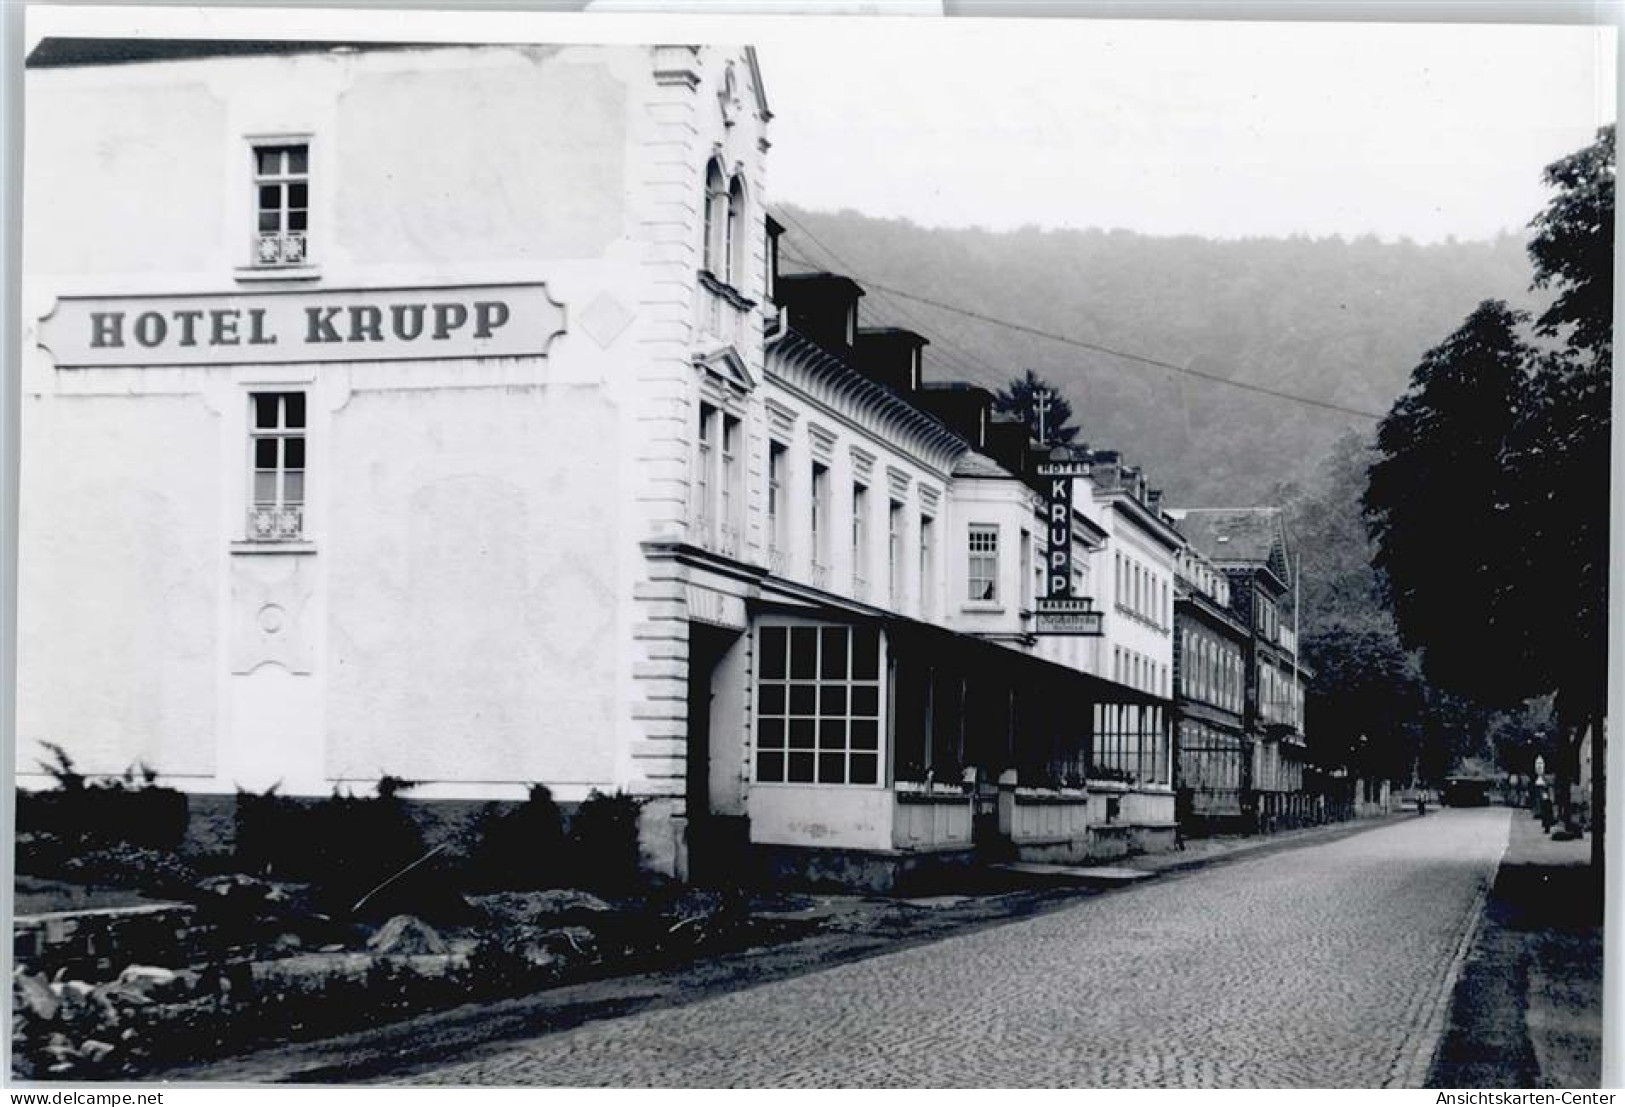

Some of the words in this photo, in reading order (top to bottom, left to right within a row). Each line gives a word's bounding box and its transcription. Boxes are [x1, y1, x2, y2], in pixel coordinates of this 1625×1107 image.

[89, 308, 277, 348] HOTEL
[305, 301, 509, 343] KRUPP
[1052, 479, 1067, 594] KRUPP
